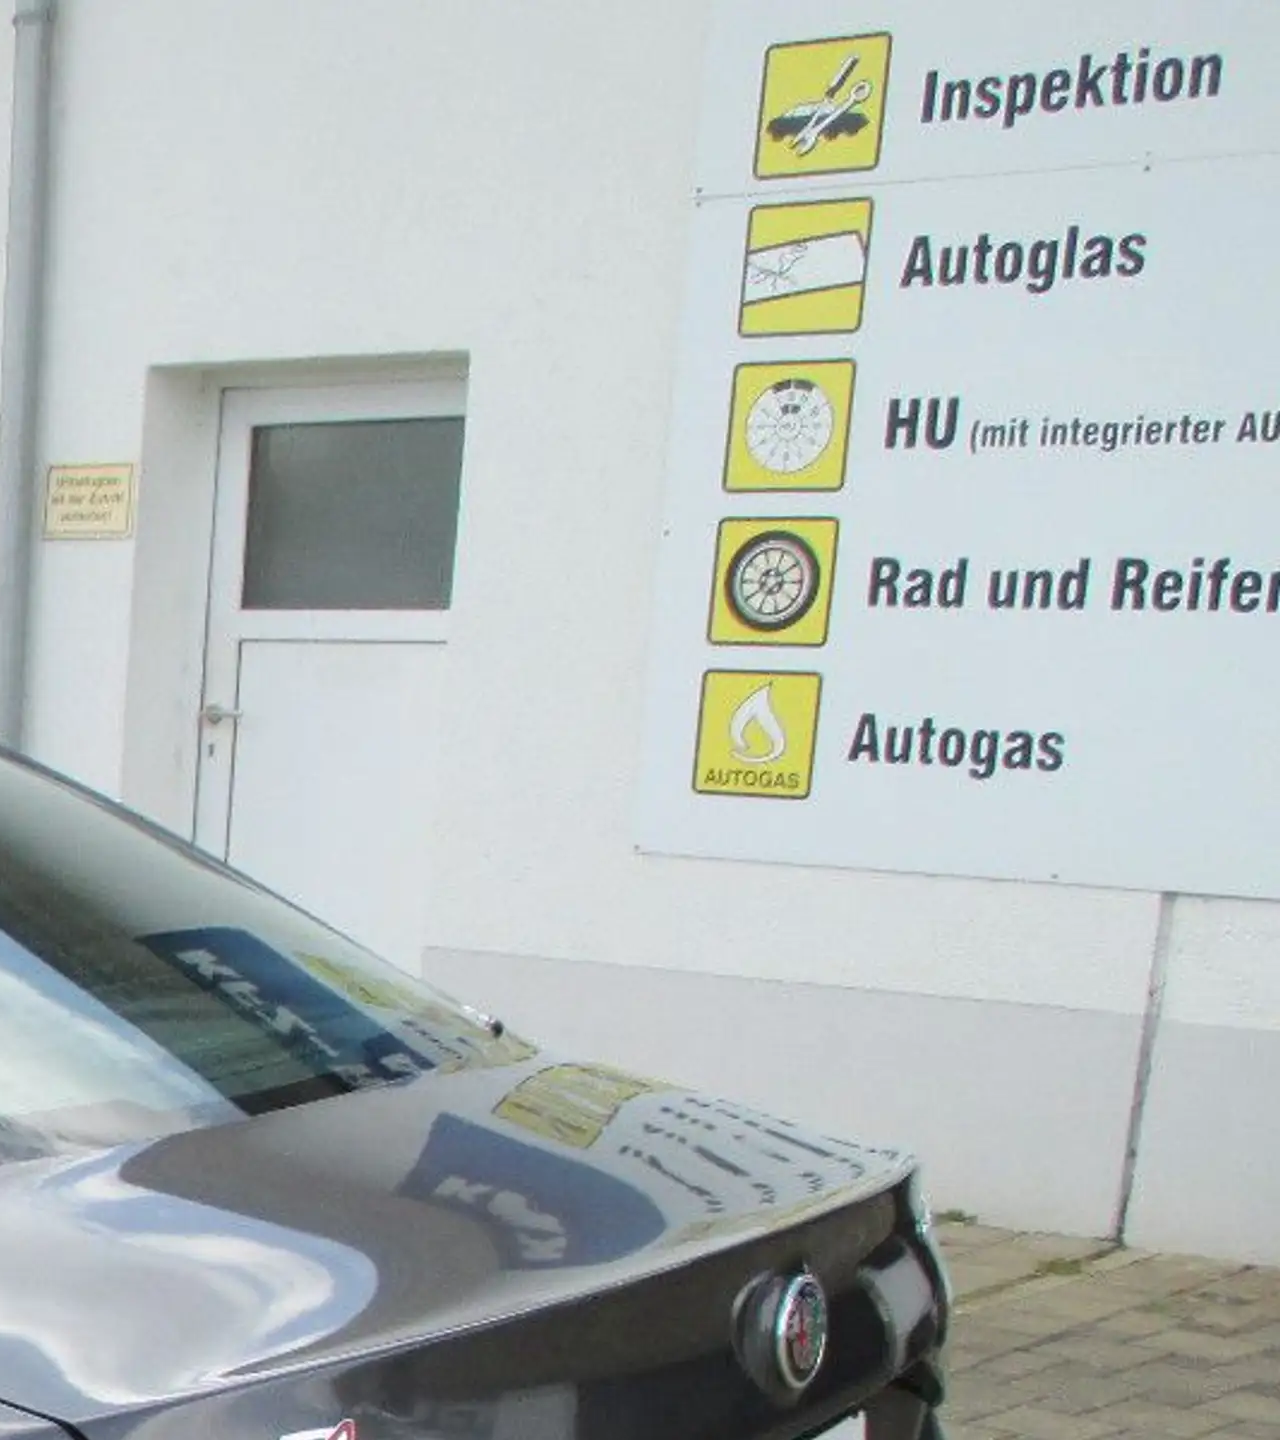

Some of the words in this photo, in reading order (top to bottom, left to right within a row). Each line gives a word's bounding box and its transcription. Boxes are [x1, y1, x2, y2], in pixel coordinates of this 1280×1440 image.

[921, 48, 1222, 128] Inspektion
[900, 225, 1146, 293] Autoglas
[885, 397, 959, 449] HU
[970, 418, 1029, 454] (mit
[1040, 414, 1226, 452] integrierter
[868, 557, 968, 608] Rad
[987, 557, 1090, 610] und
[848, 713, 1065, 780] Autogas
[704, 767, 800, 790] AUTOGAS
